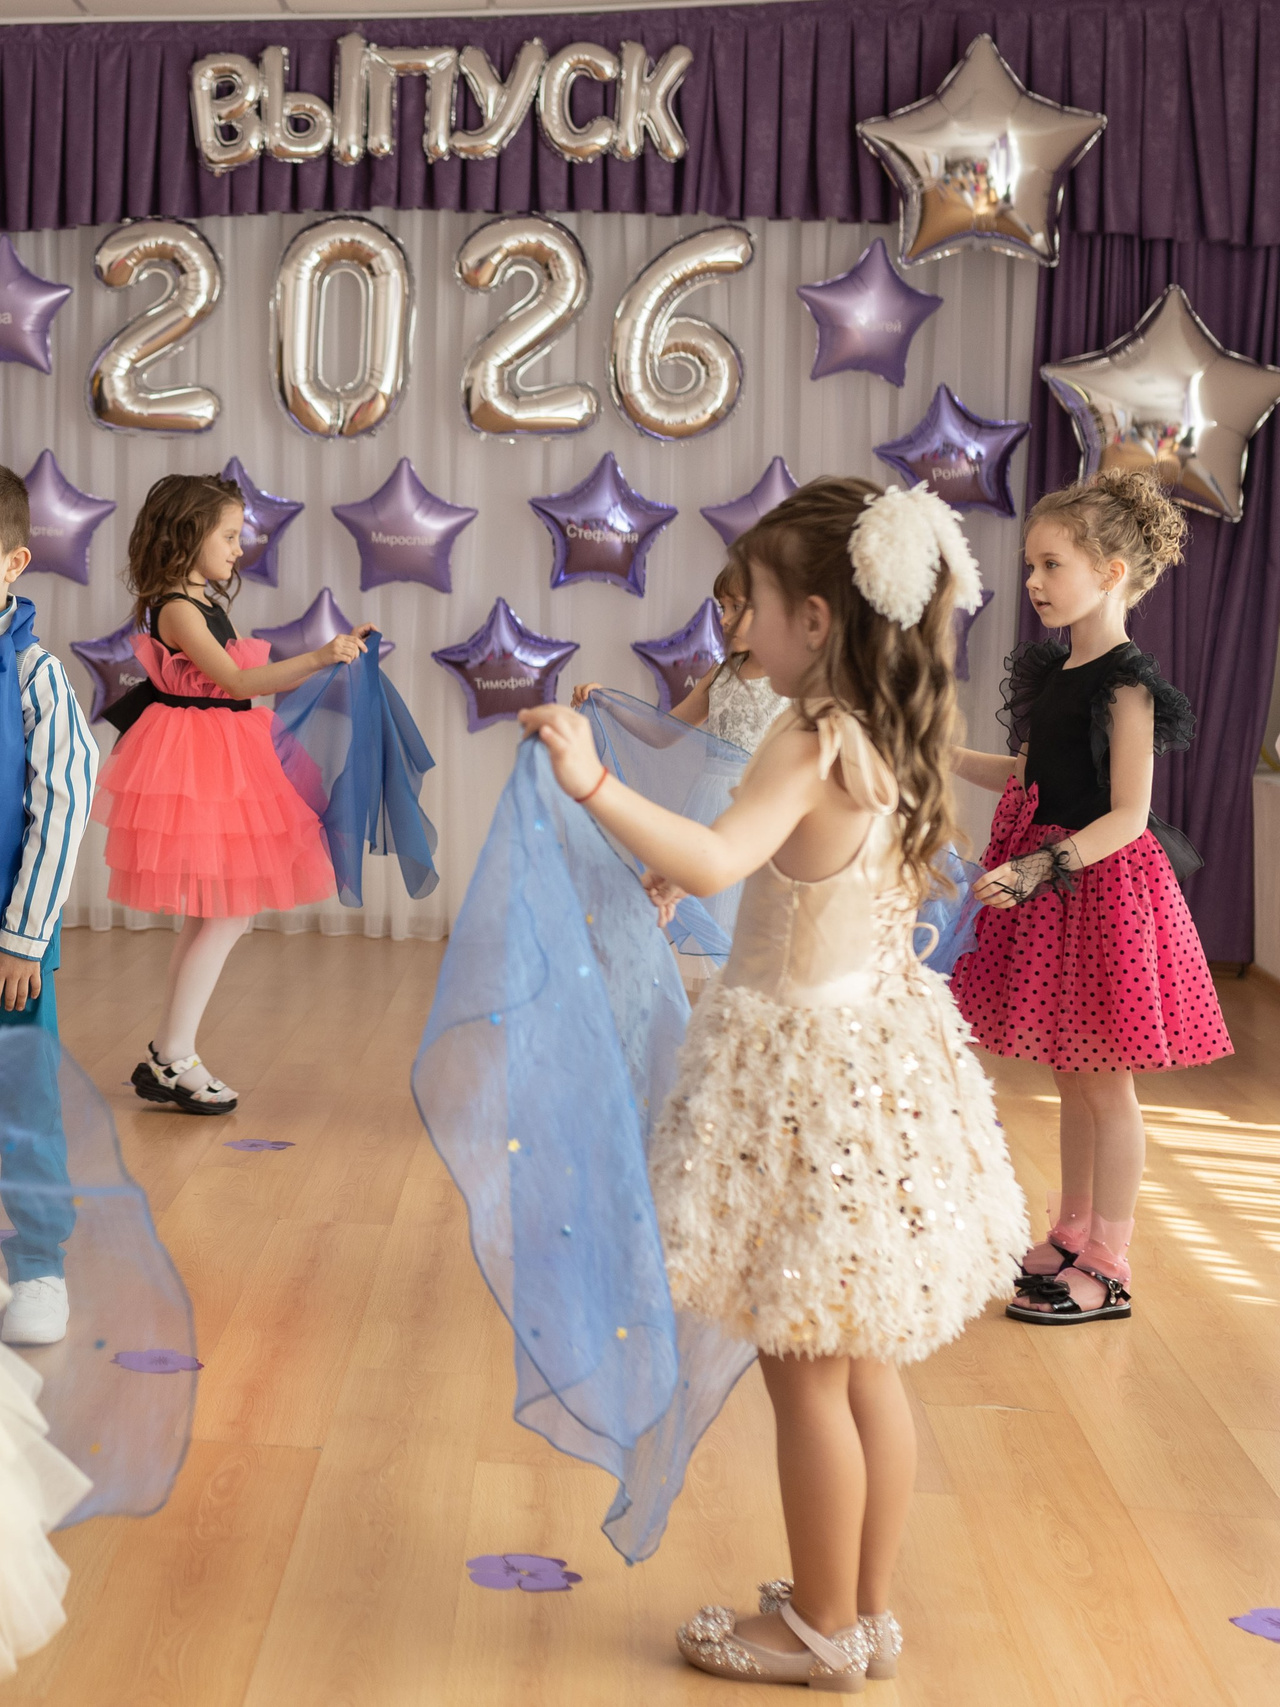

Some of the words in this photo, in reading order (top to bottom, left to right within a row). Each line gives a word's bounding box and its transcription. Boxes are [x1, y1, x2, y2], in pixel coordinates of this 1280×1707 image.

[190, 30, 693, 176] ВЫПУСК
[86, 214, 758, 443] 2026
[474, 675, 536, 691] Тимофей
